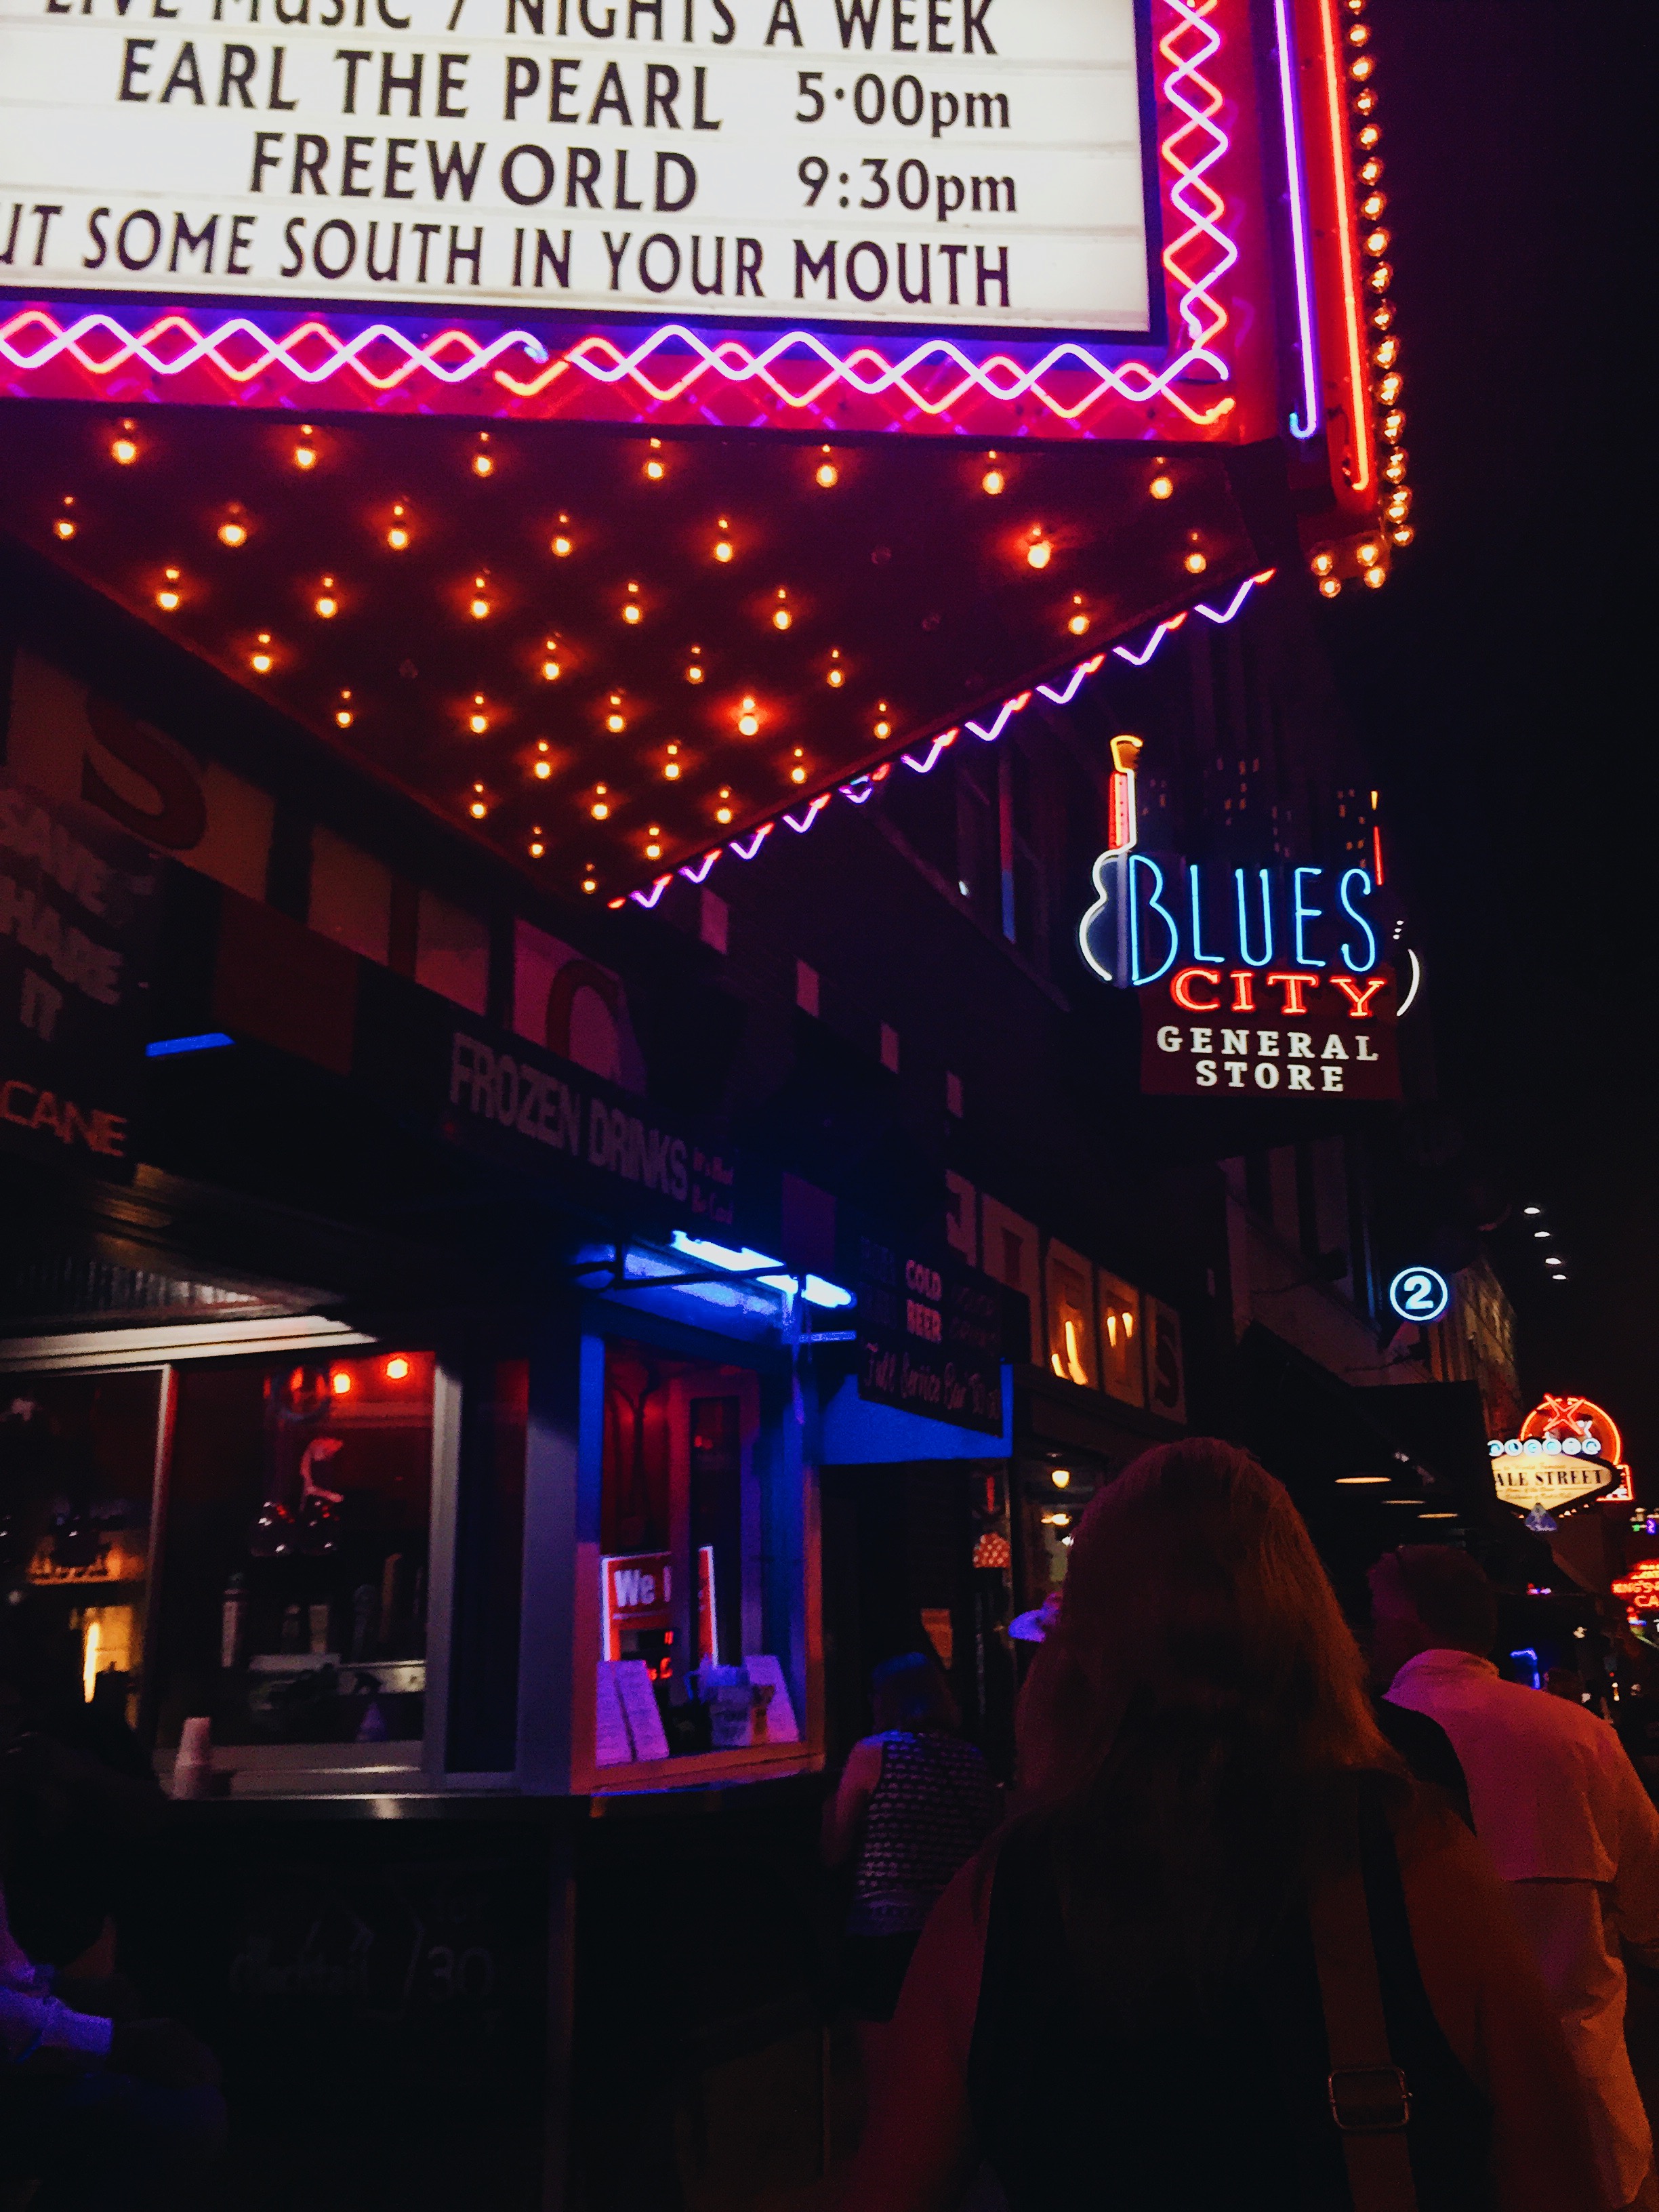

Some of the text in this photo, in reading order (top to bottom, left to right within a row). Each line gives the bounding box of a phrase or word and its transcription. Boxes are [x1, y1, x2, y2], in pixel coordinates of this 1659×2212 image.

[766, 0, 803, 47] A
[835, 0, 996, 55] WEEK
[119, 38, 296, 110] EARL
[335, 49, 469, 118] THE
[505, 56, 720, 131] PEARL
[250, 131, 1017, 222] FREEWORLD 9:30pm
[83, 207, 255, 275] SOME
[281, 217, 483, 287] SOUTH
[512, 228, 572, 289] IN
[602, 232, 764, 298] YOUR
[793, 239, 1010, 308] MOUTH
[1128, 853, 1377, 987] BLUES
[1170, 967, 1387, 1018] CITY
[1155, 1024, 1380, 1062] GENERAL
[1194, 1059, 1345, 1093] STORE
[449, 1030, 689, 1202] FROZEN DRINKS
[905, 1259, 943, 1302] COLD
[1404, 1275, 1435, 1311] 2
[906, 1298, 943, 1345] BEER
[1535, 1469, 1603, 1486] STREET
[613, 1569, 656, 1608] We
